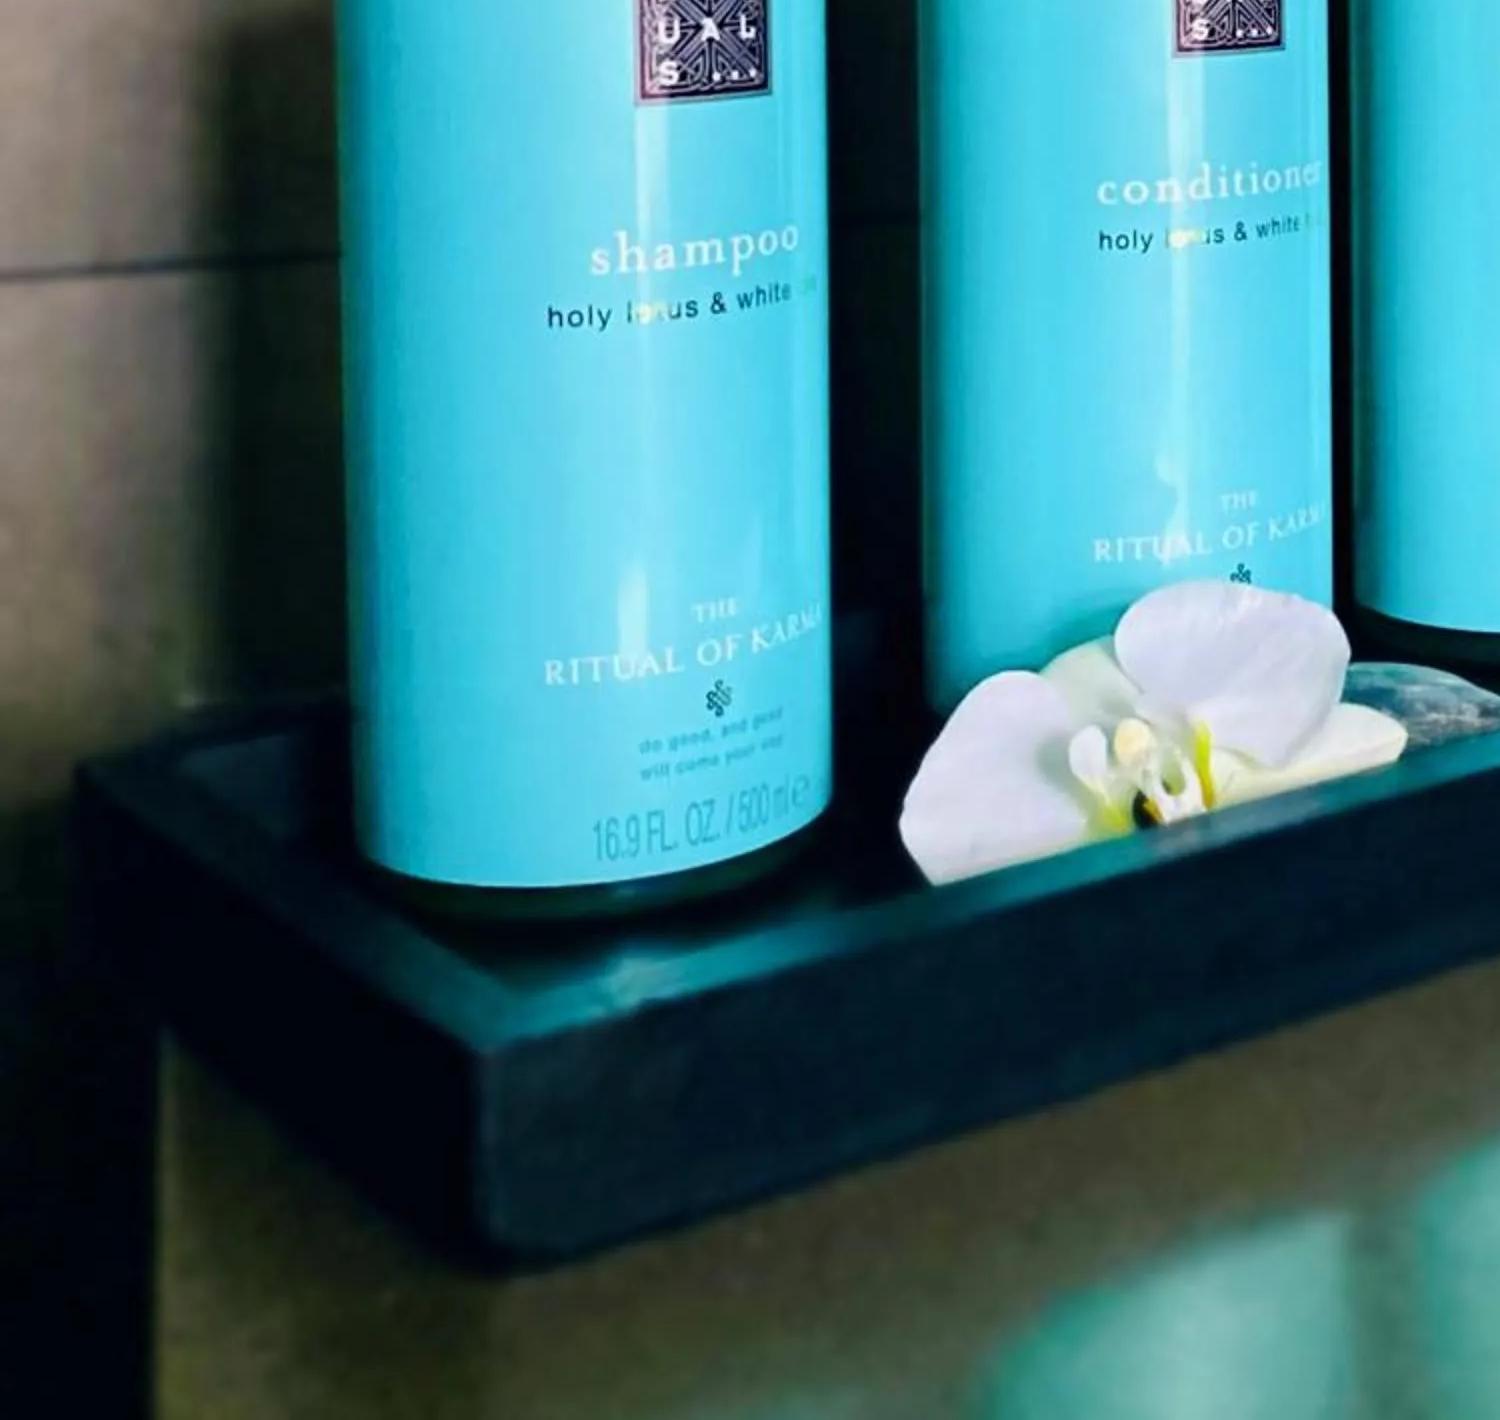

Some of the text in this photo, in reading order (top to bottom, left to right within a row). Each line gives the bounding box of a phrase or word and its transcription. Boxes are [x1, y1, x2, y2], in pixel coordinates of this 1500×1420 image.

[589, 225, 799, 277] shampoo
[1098, 228, 1153, 254] holy
[1233, 220, 1249, 242] &
[1255, 214, 1301, 239] white
[547, 303, 612, 332] holy
[710, 291, 727, 314] &
[736, 281, 791, 310] white
[1092, 531, 1213, 564] RITUAL
[1221, 521, 1261, 550] OF
[693, 597, 739, 623] THE
[544, 645, 686, 686] RITUAL
[697, 632, 744, 667] OF
[593, 813, 641, 862] 16.9
[646, 808, 679, 855] FL.
